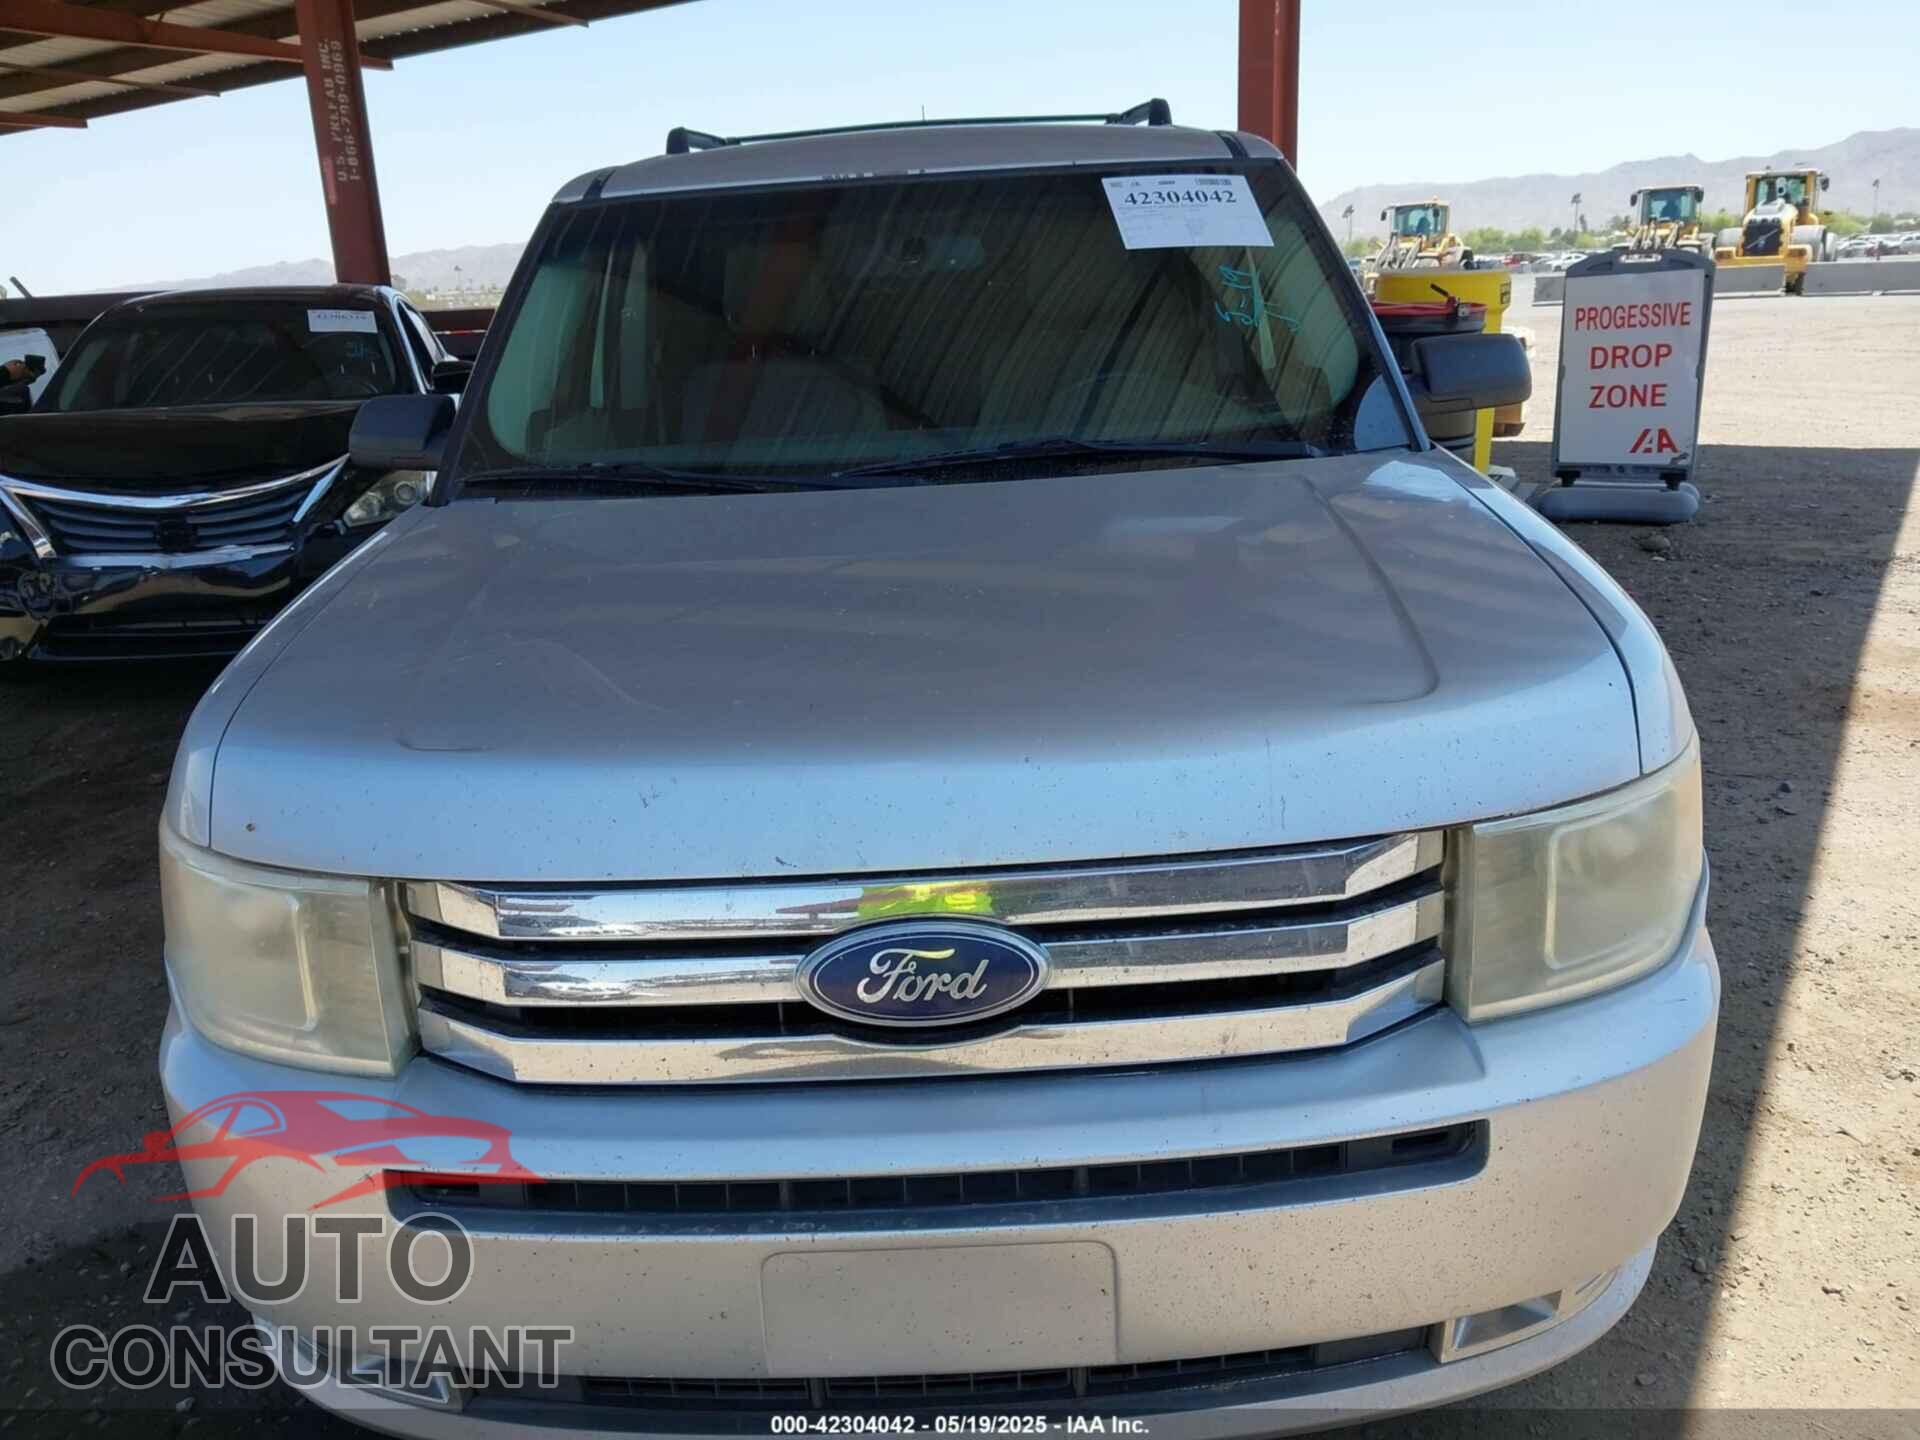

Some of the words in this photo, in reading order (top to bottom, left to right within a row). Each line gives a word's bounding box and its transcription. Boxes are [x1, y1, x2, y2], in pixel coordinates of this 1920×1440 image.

[1124, 189, 1237, 205] 42304042
[1575, 301, 1692, 331] PROGESSIVE
[1589, 343, 1673, 370] DROP
[1588, 383, 1668, 409] ZONE
[856, 947, 989, 1004] Ford
